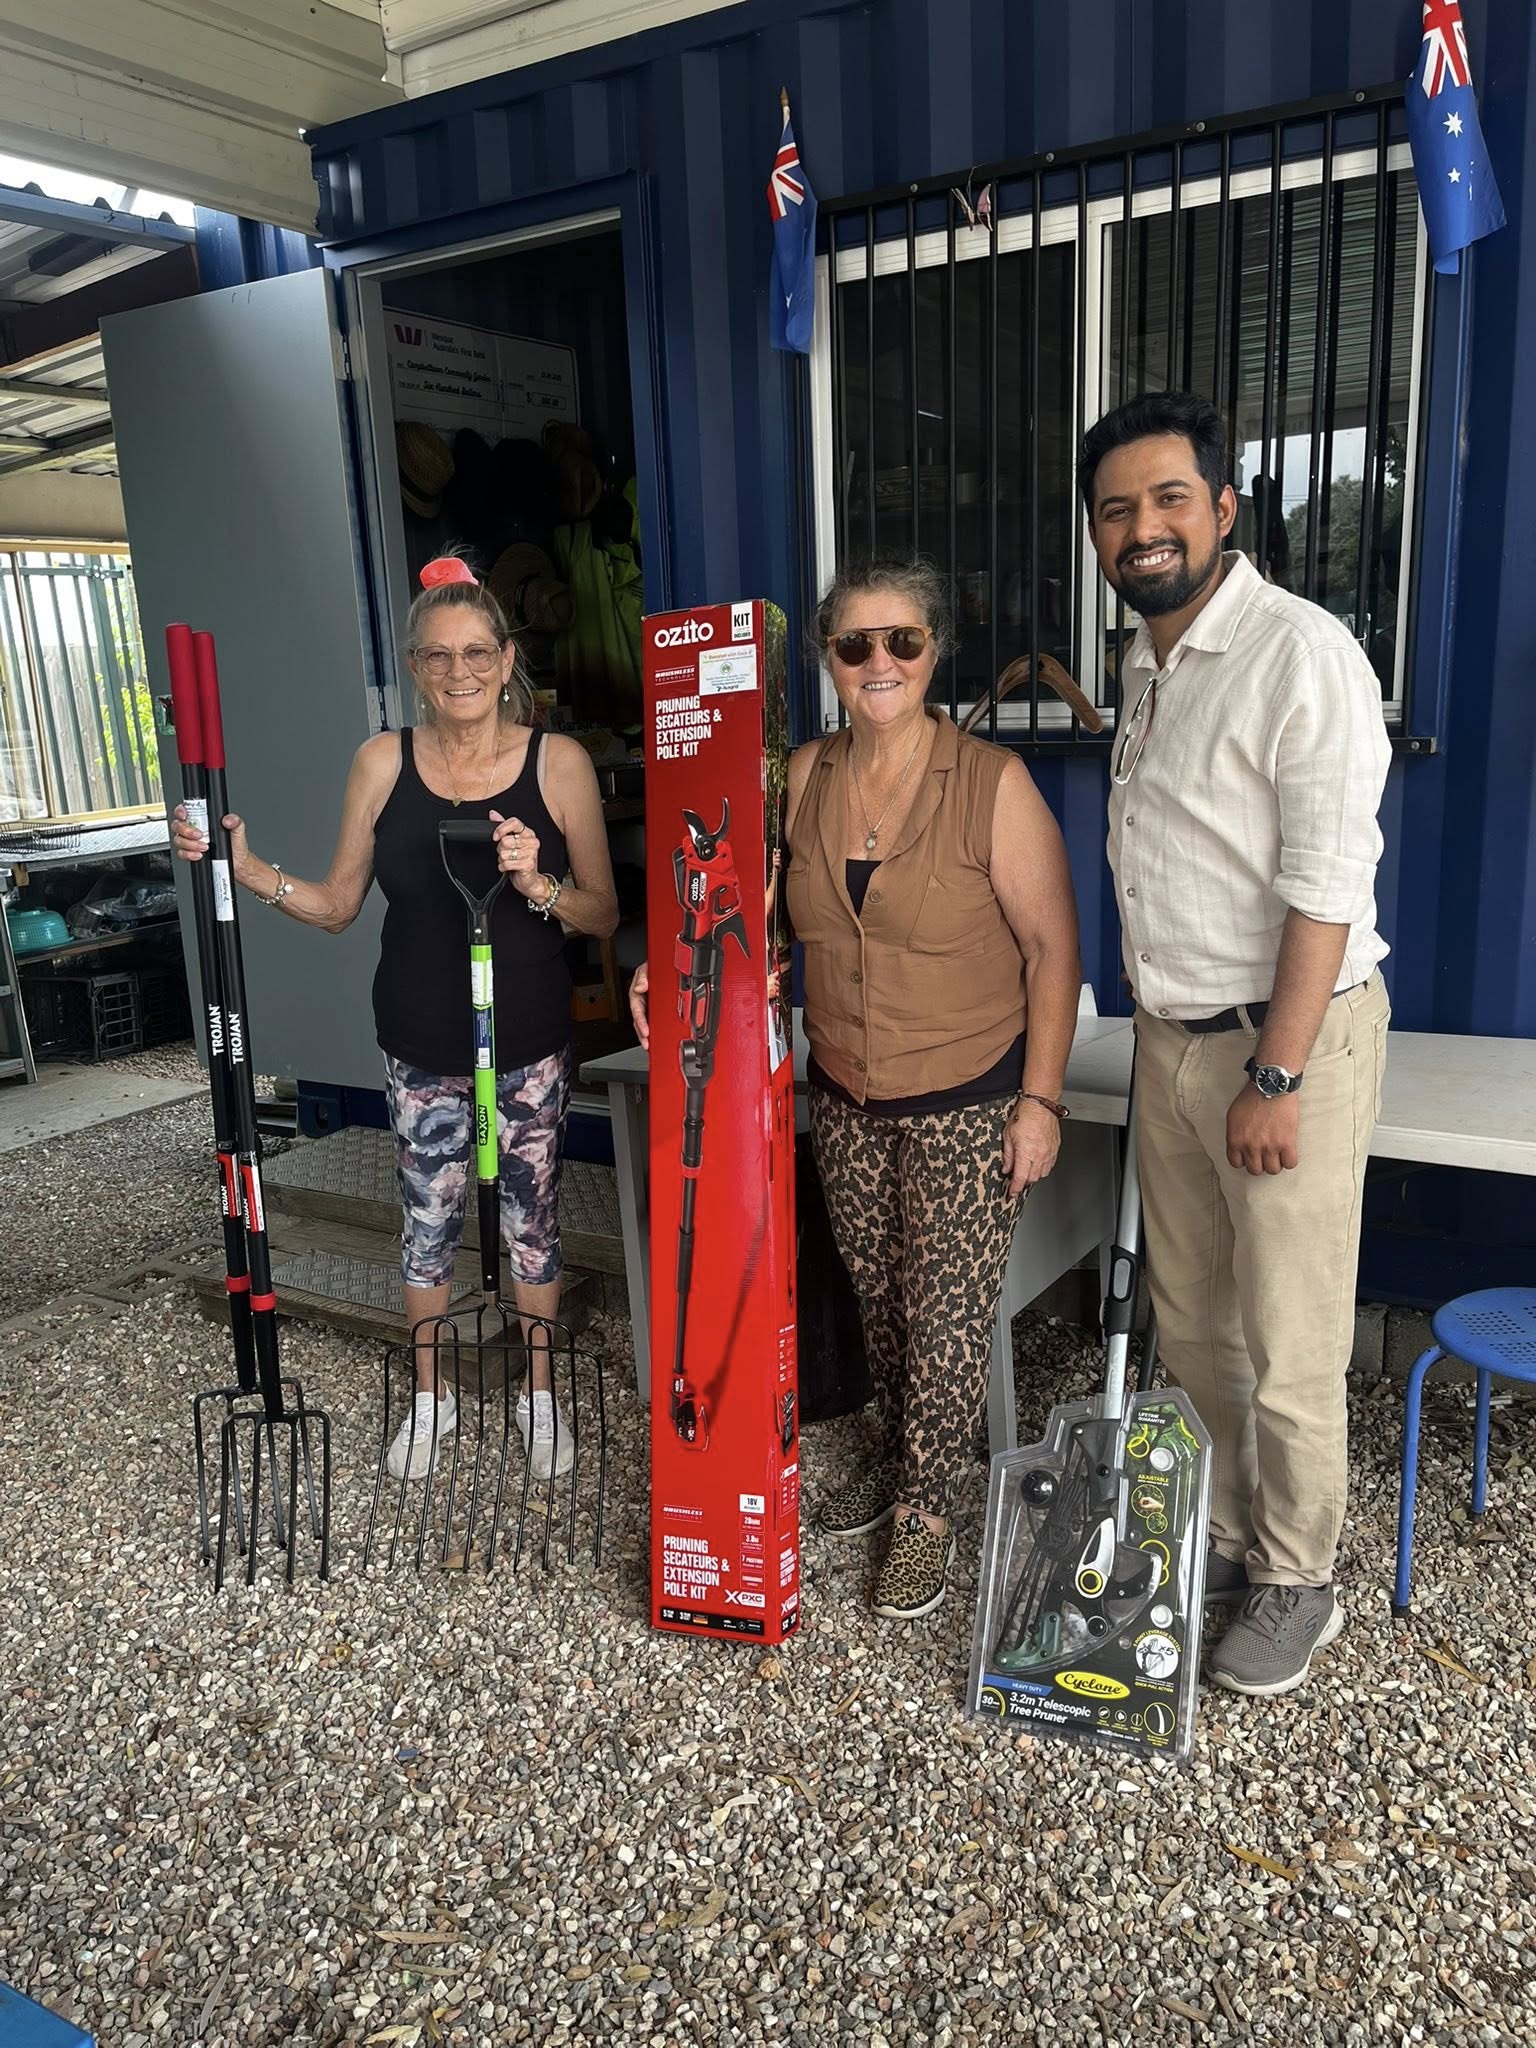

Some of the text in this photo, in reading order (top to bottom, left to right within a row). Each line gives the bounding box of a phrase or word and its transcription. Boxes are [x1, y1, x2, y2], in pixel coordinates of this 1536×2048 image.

[734, 612, 750, 627] KIT
[654, 619, 714, 648] ozito
[656, 695, 700, 715] PRUNING
[656, 708, 722, 730] SECATEURS &
[656, 725, 712, 745] EXTENSION
[656, 741, 699, 760] POLE KIT
[208, 1004, 225, 1056] TROJAN
[228, 1012, 245, 1065] TROJAN
[480, 1105, 488, 1146] SAXON
[221, 1185, 229, 1216] TROJAN
[243, 1198, 251, 1230] TROJAN
[1138, 1411, 1159, 1419] LIFETIME
[1138, 1416, 1166, 1425] GUARANTEE
[1138, 1474, 1169, 1483] ADJUSTABLE
[747, 1498, 758, 1506] 18V
[663, 1535, 709, 1554] PRUNING
[663, 1551, 719, 1571] SECATEURS
[721, 1558, 730, 1572] &
[663, 1566, 720, 1586] EXTENSION
[663, 1581, 707, 1600] POLE KIT
[741, 1593, 763, 1603] PXC
[1012, 1682, 1028, 1690] HEAVY
[1063, 1673, 1122, 1695] Cyclone
[1010, 1691, 1091, 1718] 3.2m Telescopic
[1010, 1703, 1032, 1716] Tree
[1033, 1708, 1067, 1724] Pruner
